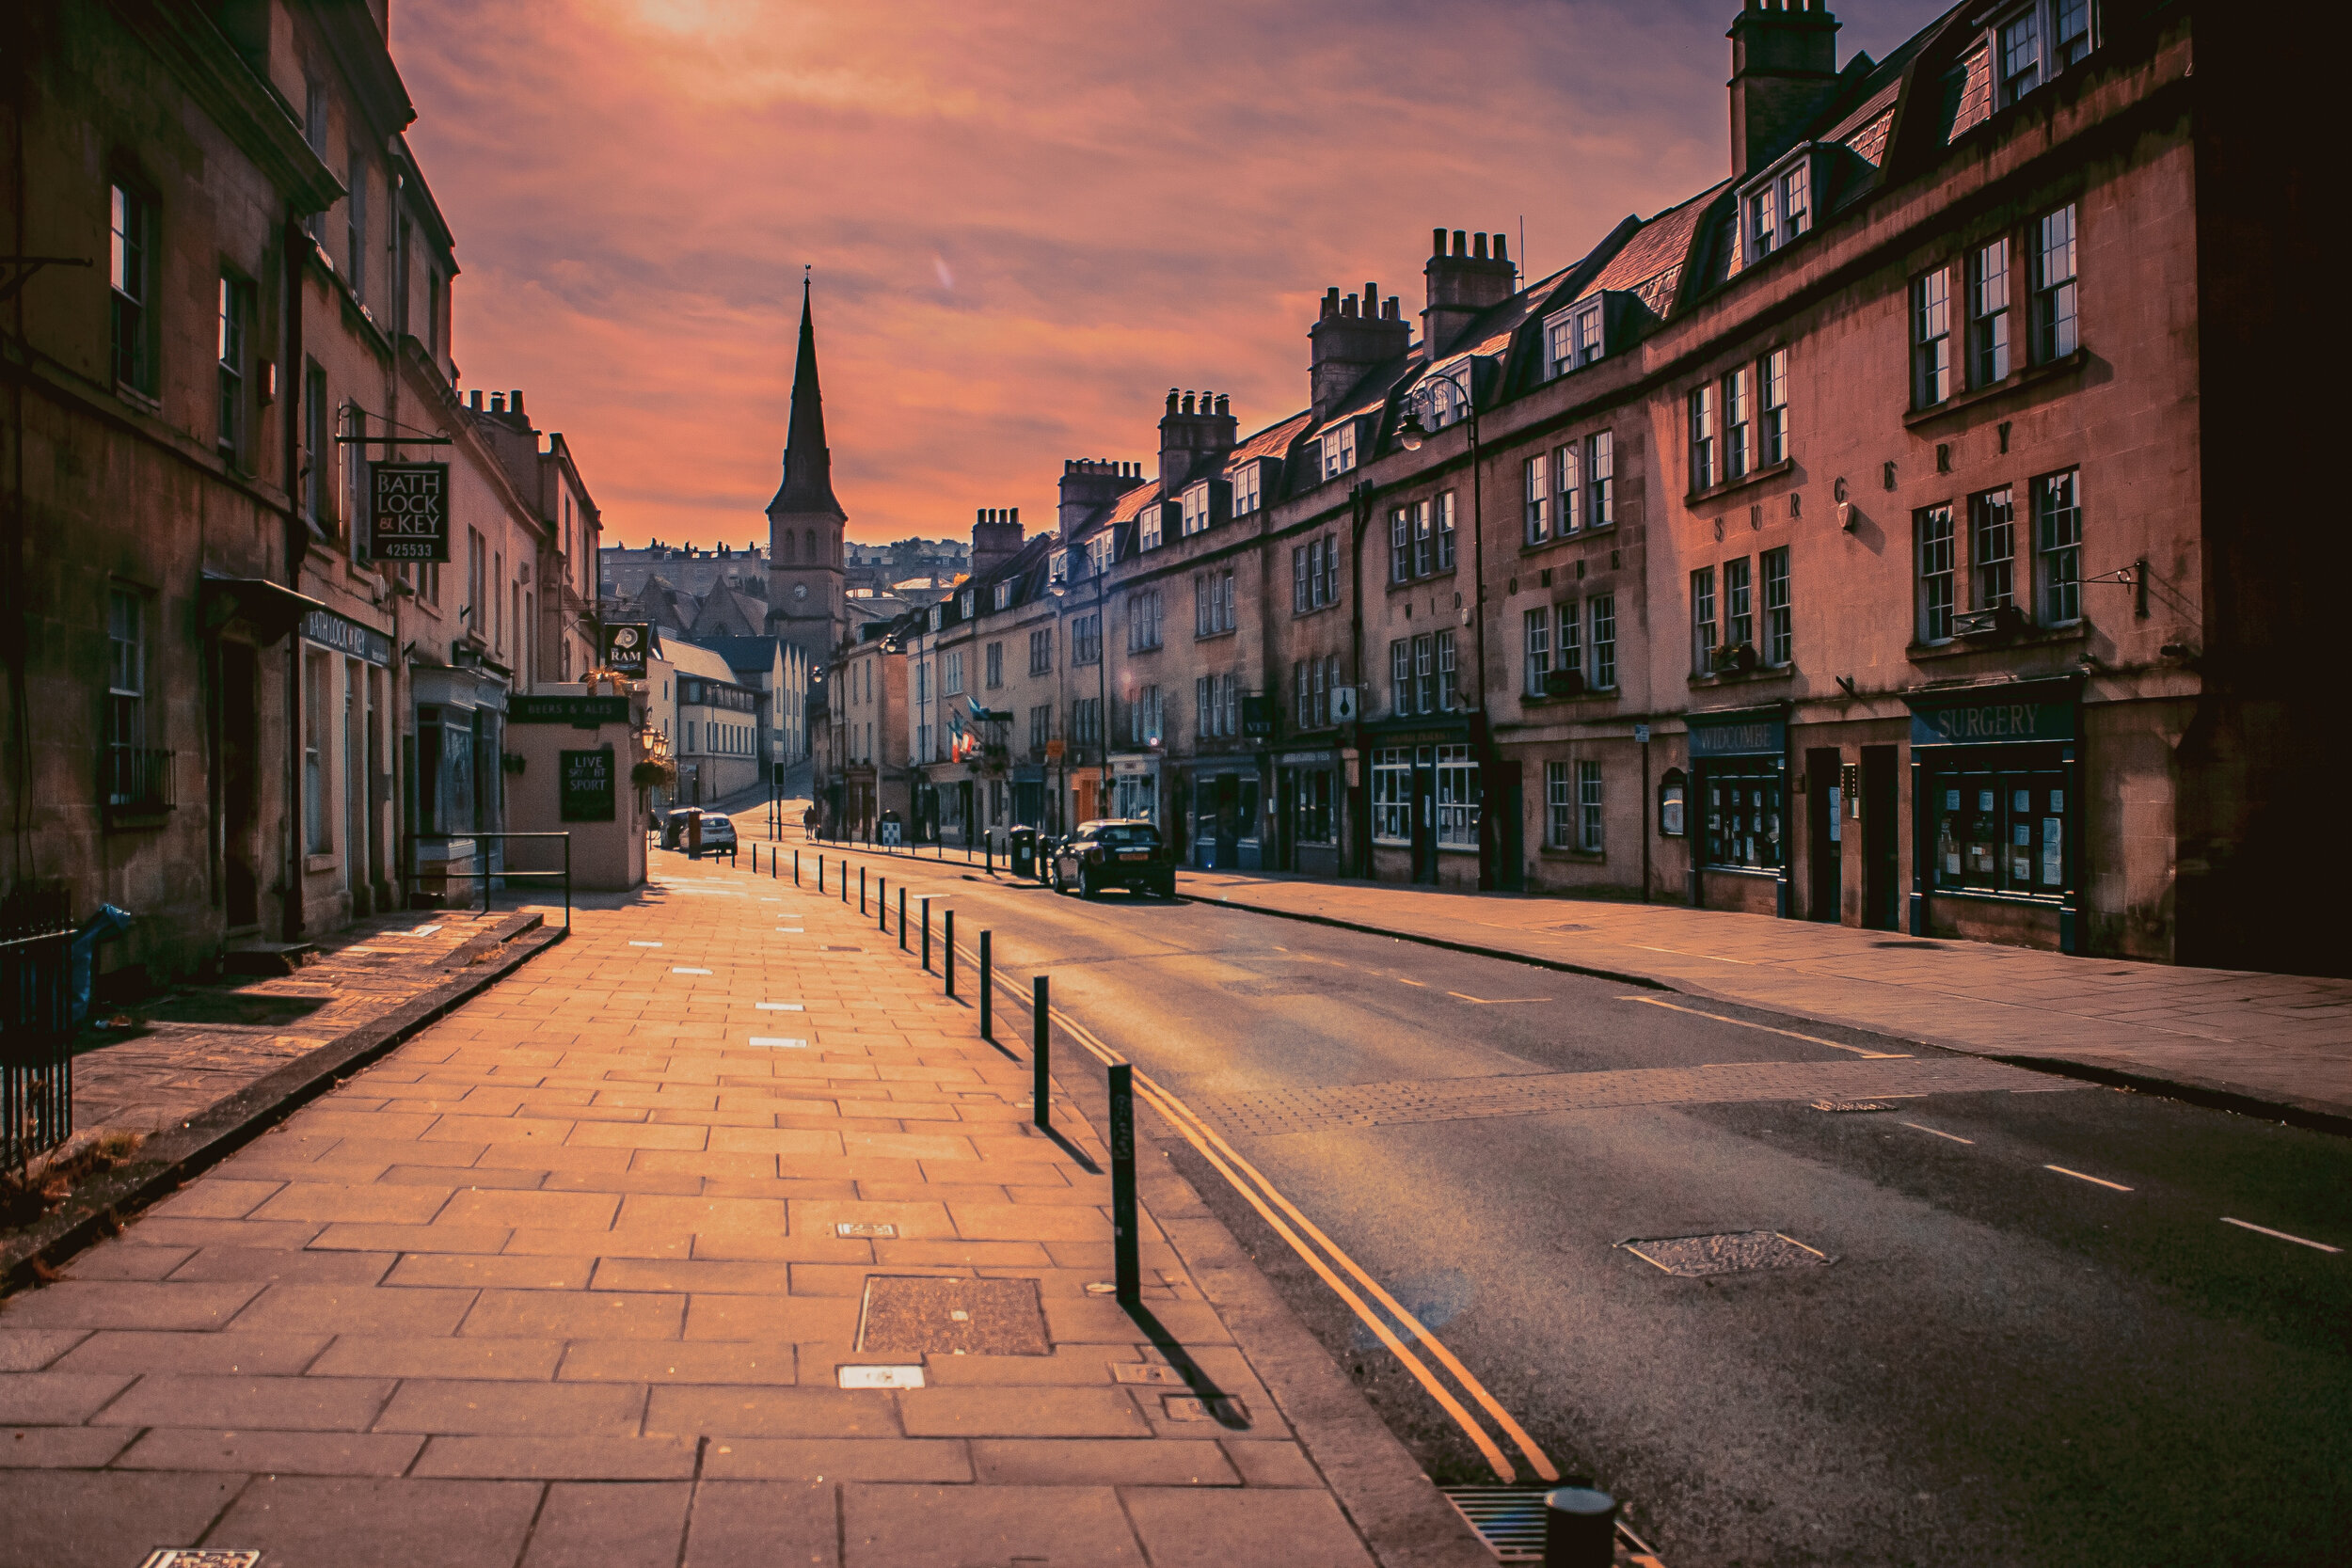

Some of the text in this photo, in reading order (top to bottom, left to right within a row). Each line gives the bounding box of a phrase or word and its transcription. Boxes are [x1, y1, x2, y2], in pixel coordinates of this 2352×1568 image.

[377, 474, 439, 494] BATH
[377, 494, 439, 515] LOCK
[379, 515, 439, 533] & KEY
[1405, 420, 2011, 620] WIDCOMBE SURGERY
[386, 544, 432, 557] 425533
[611, 651, 642, 661] RAM
[528, 704, 612, 715] BEERS & ALES
[1938, 703, 2040, 738] SURGERY
[1700, 723, 1772, 751] WIDCOMBE
[575, 756, 603, 768] LIVE
[570, 779, 608, 791] SPORT
